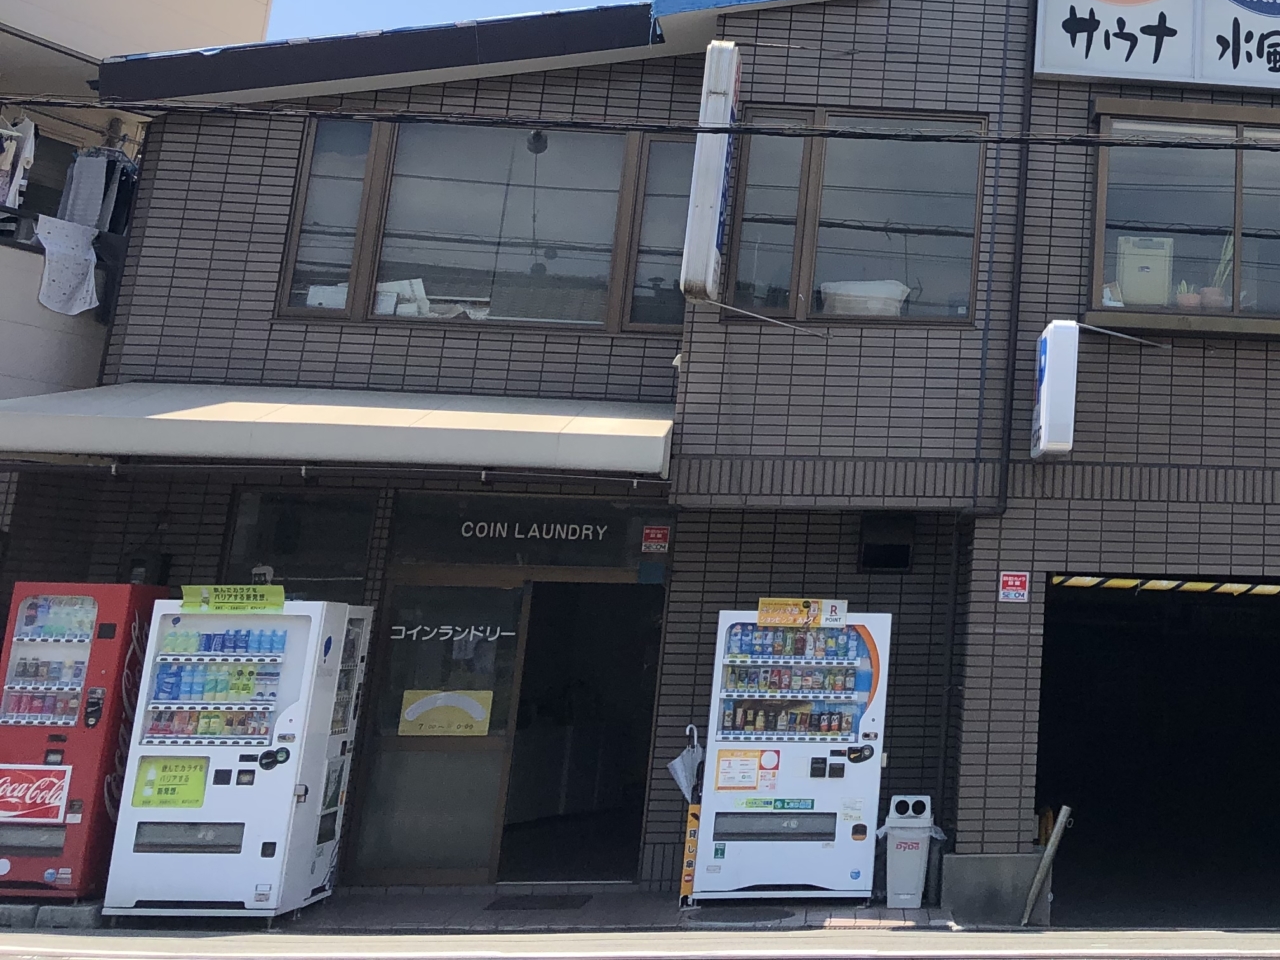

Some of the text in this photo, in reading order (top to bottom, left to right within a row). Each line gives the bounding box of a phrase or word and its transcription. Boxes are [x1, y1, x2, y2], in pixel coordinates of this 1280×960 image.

[1061, 4, 1178, 64] サウナ
[461, 521, 608, 541] COIN LAUNDRY
[390, 625, 516, 642] コインランドリー
[895, 841, 920, 852] DyDo
